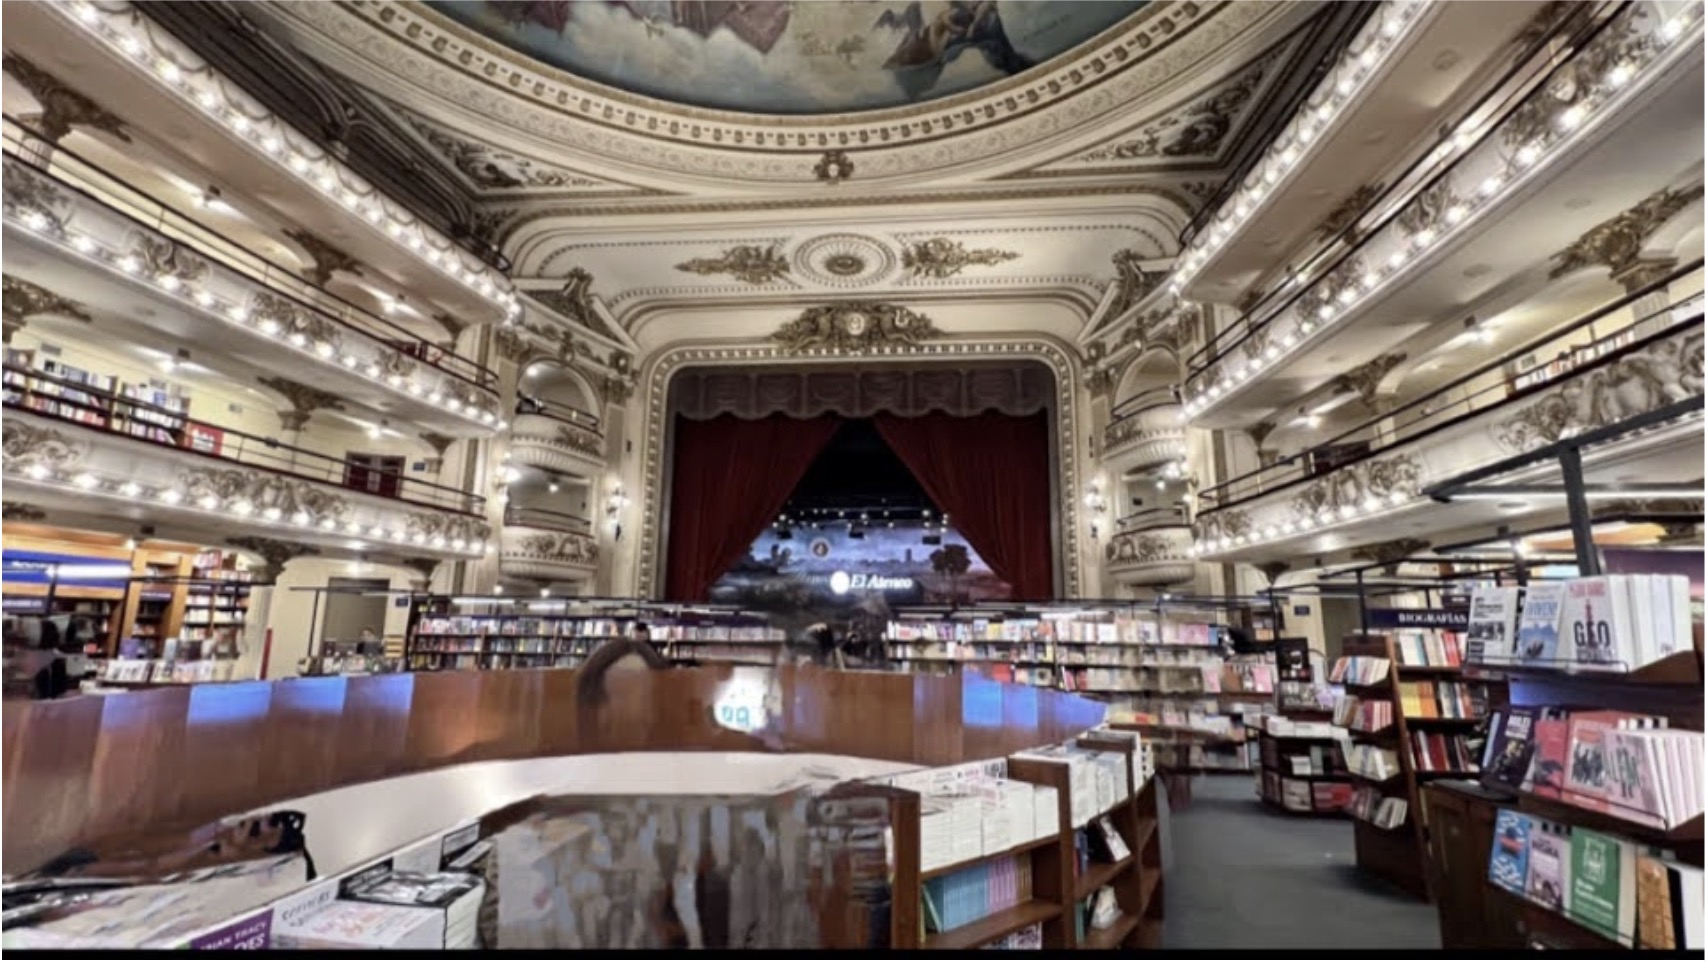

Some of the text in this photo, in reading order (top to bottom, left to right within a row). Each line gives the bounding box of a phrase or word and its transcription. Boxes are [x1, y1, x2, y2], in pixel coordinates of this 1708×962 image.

[851, 573, 914, 589] El Ateneo
[200, 937, 232, 951] RIAN
